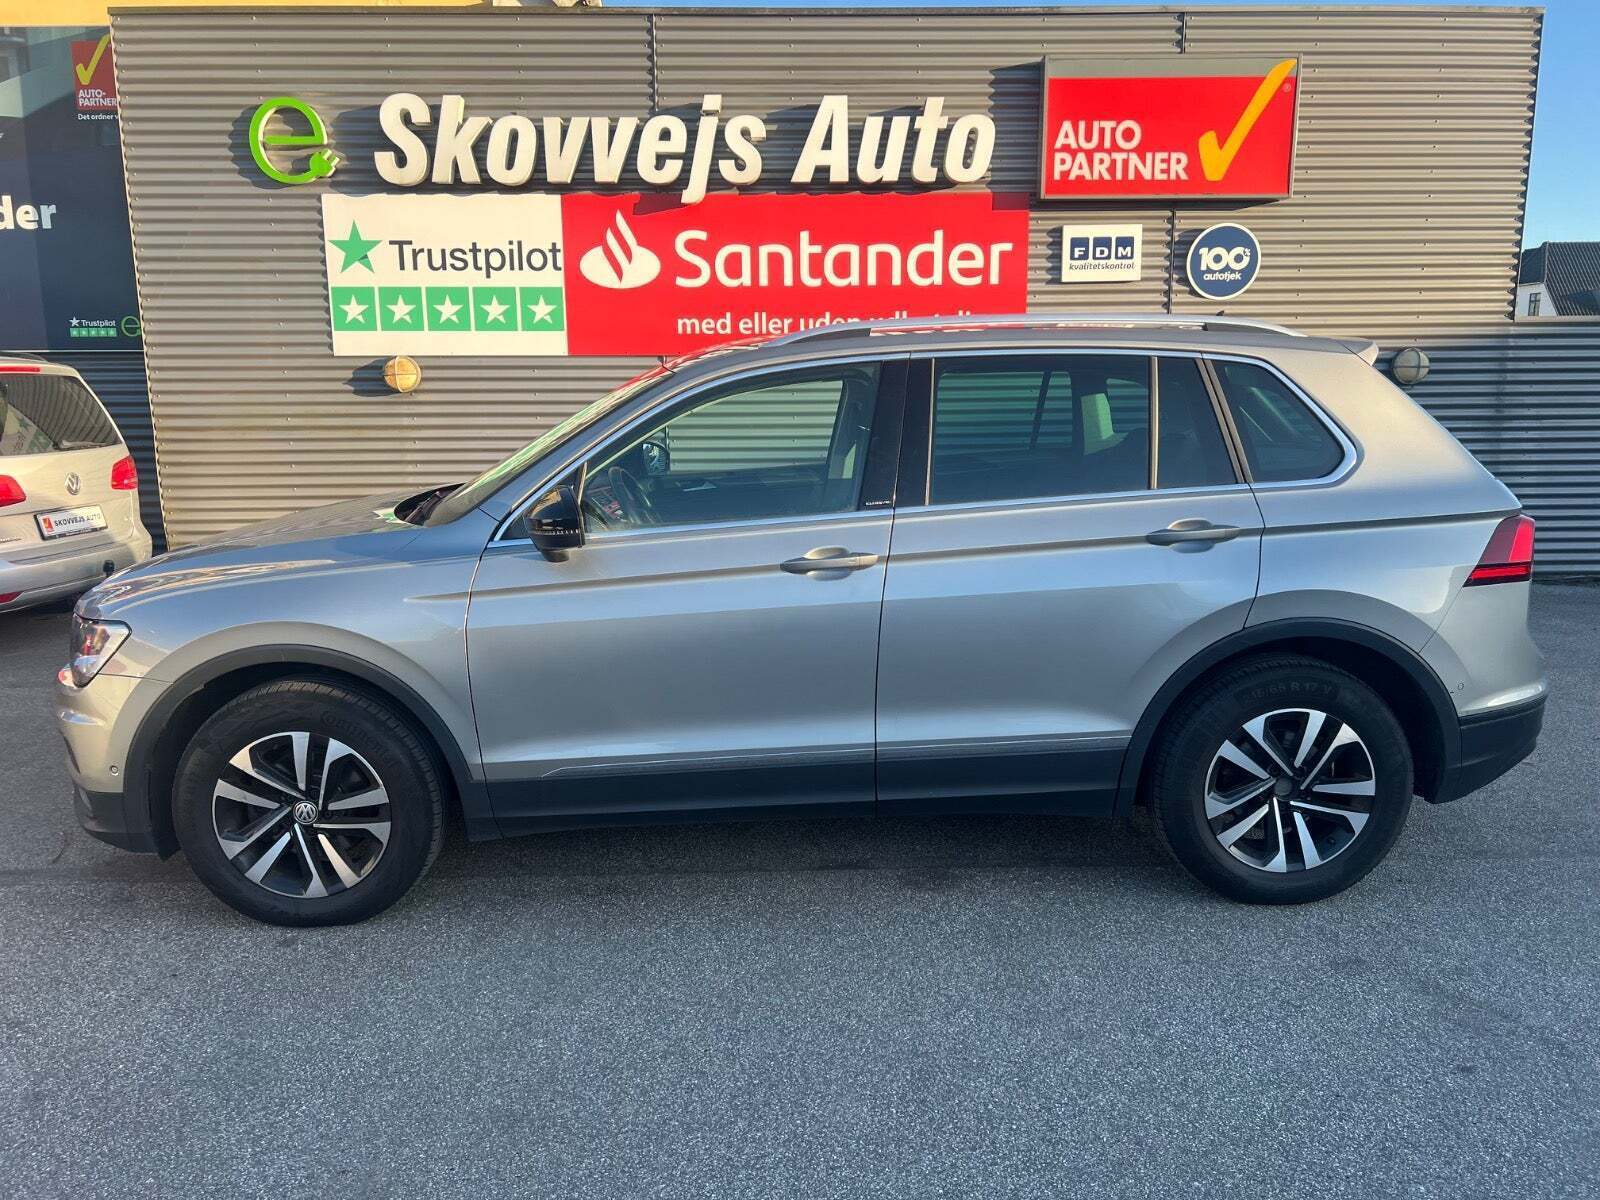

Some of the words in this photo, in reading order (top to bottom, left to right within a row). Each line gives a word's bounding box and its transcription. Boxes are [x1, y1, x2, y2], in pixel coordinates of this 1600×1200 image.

[373, 92, 767, 204] Skovvejs
[790, 94, 996, 185] Auto
[1054, 119, 1142, 150] AUTO
[1053, 151, 1189, 181] PARTNER
[389, 239, 561, 279] Trustpilot
[674, 229, 1013, 288] Santander
[1069, 262, 1135, 271] kvalitetskontrol
[1203, 271, 1242, 282] autotjek
[81, 319, 117, 328] Trustpilot
[677, 312, 731, 335] med
[738, 312, 792, 335] eller
